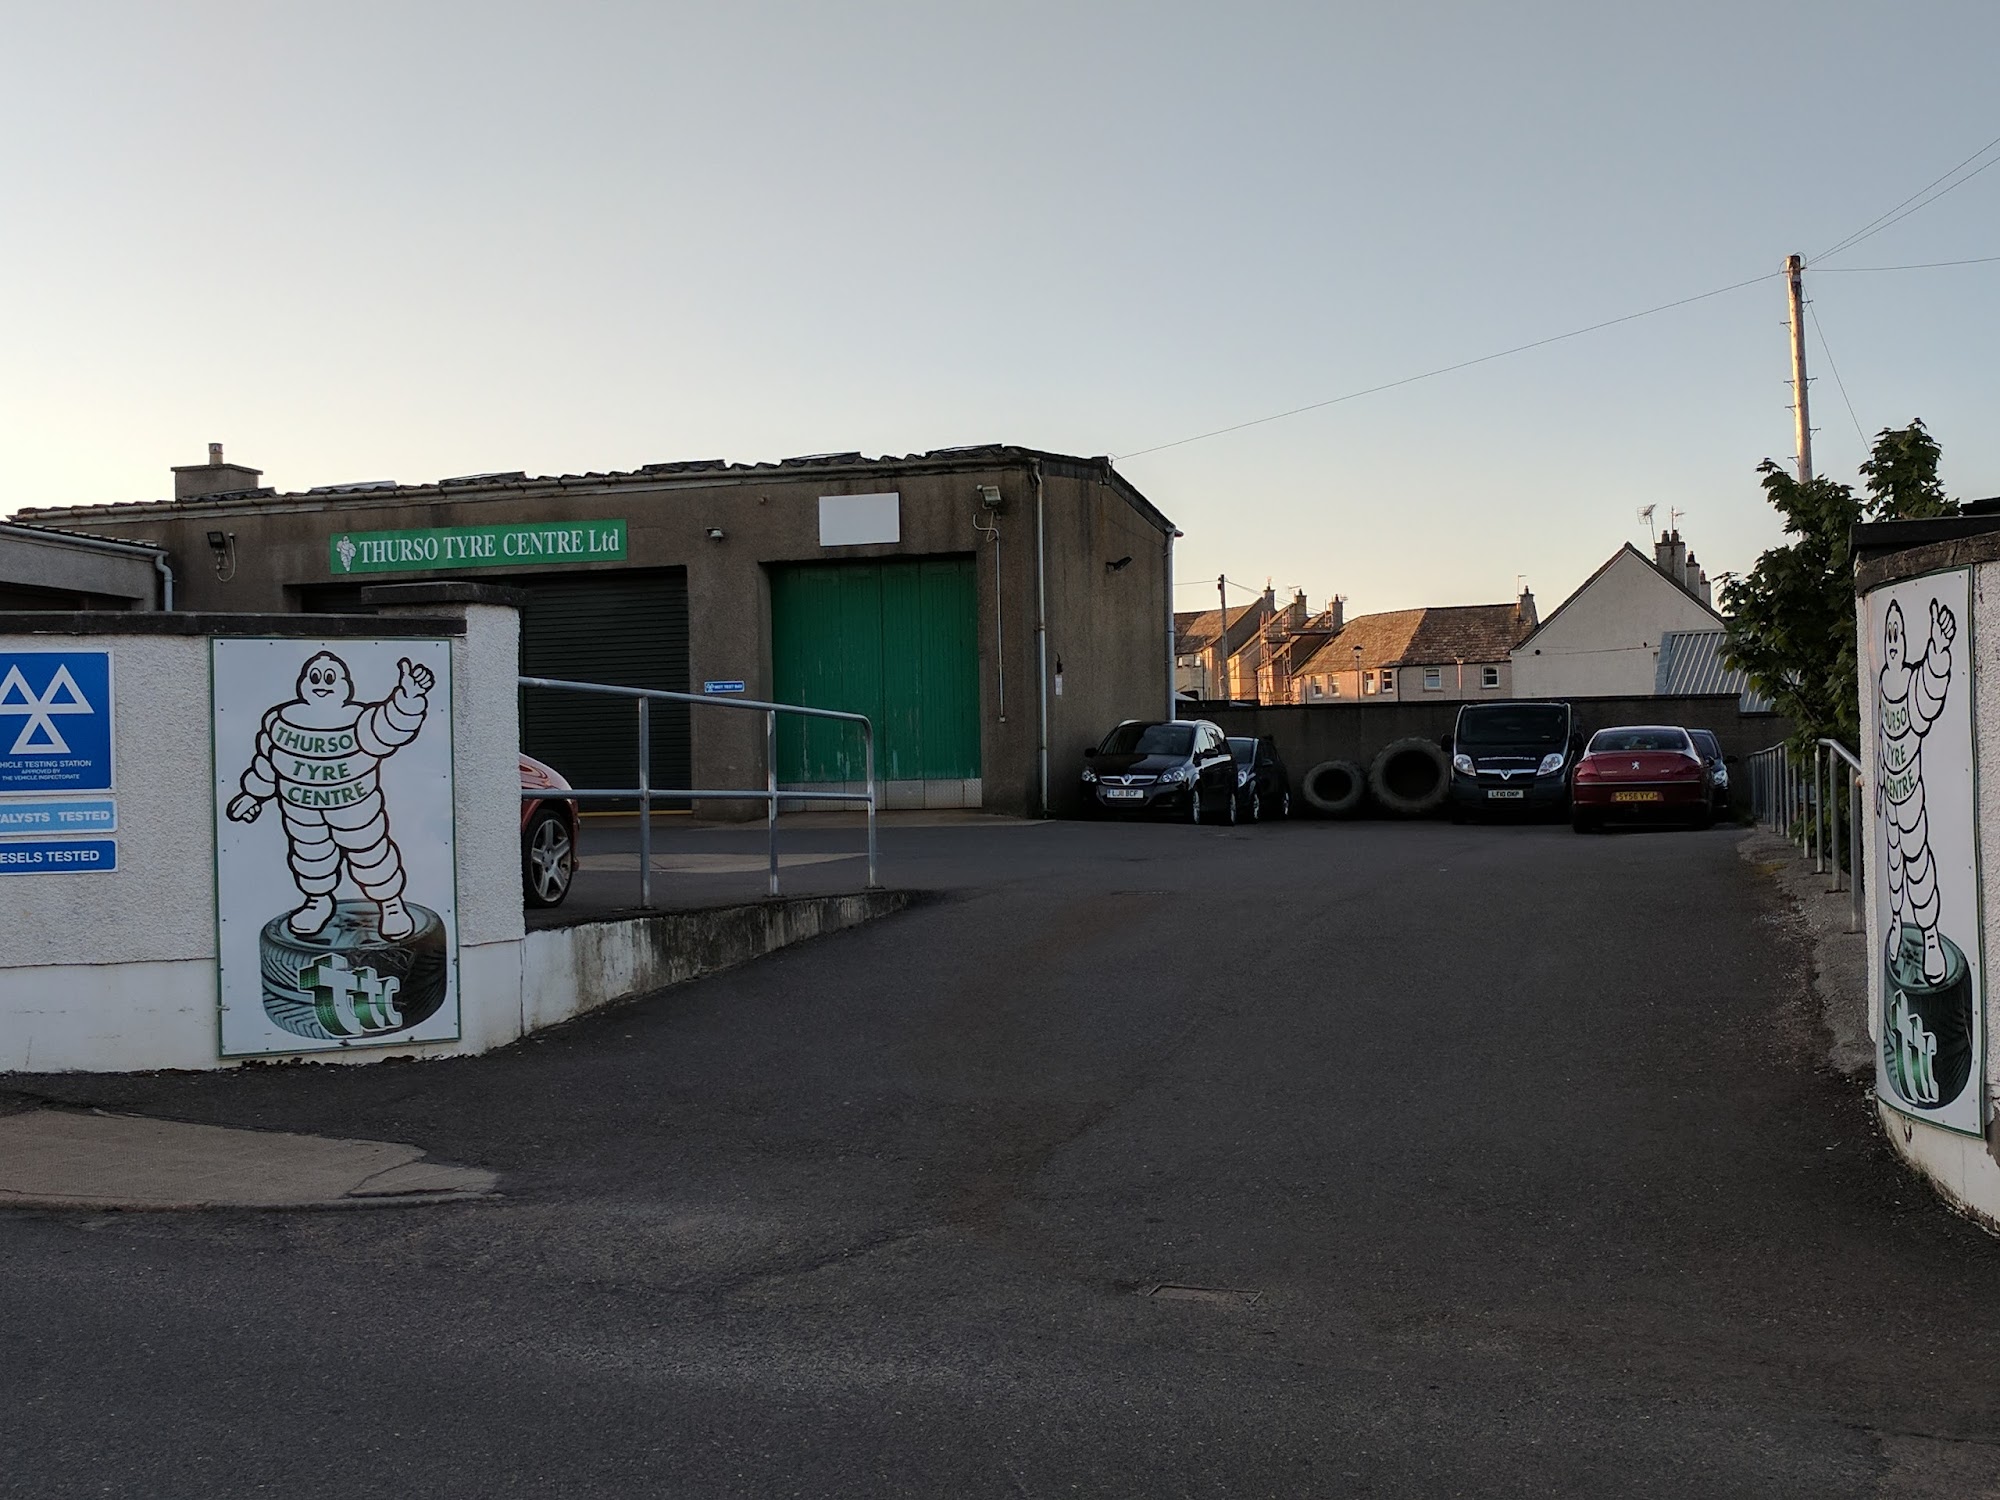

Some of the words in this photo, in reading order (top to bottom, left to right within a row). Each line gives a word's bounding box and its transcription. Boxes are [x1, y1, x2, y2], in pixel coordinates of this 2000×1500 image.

[359, 537, 439, 564] THURSO
[443, 533, 497, 560] TYRE
[503, 530, 584, 557] CENTRE
[588, 528, 620, 553] Ltd
[276, 726, 354, 753] THURSO
[0, 761, 23, 769] HICLE
[25, 760, 58, 768] TESTING
[59, 759, 92, 767] STATION
[1886, 742, 1907, 767] TYRE
[292, 760, 351, 781] TYRE
[287, 781, 368, 806] CENTRE
[1886, 769, 1915, 800] CENTRE
[0, 812, 50, 824] ALYSTS
[58, 810, 110, 822] TESTED
[0, 851, 43, 864] ESELS
[46, 850, 100, 862] TESTED
